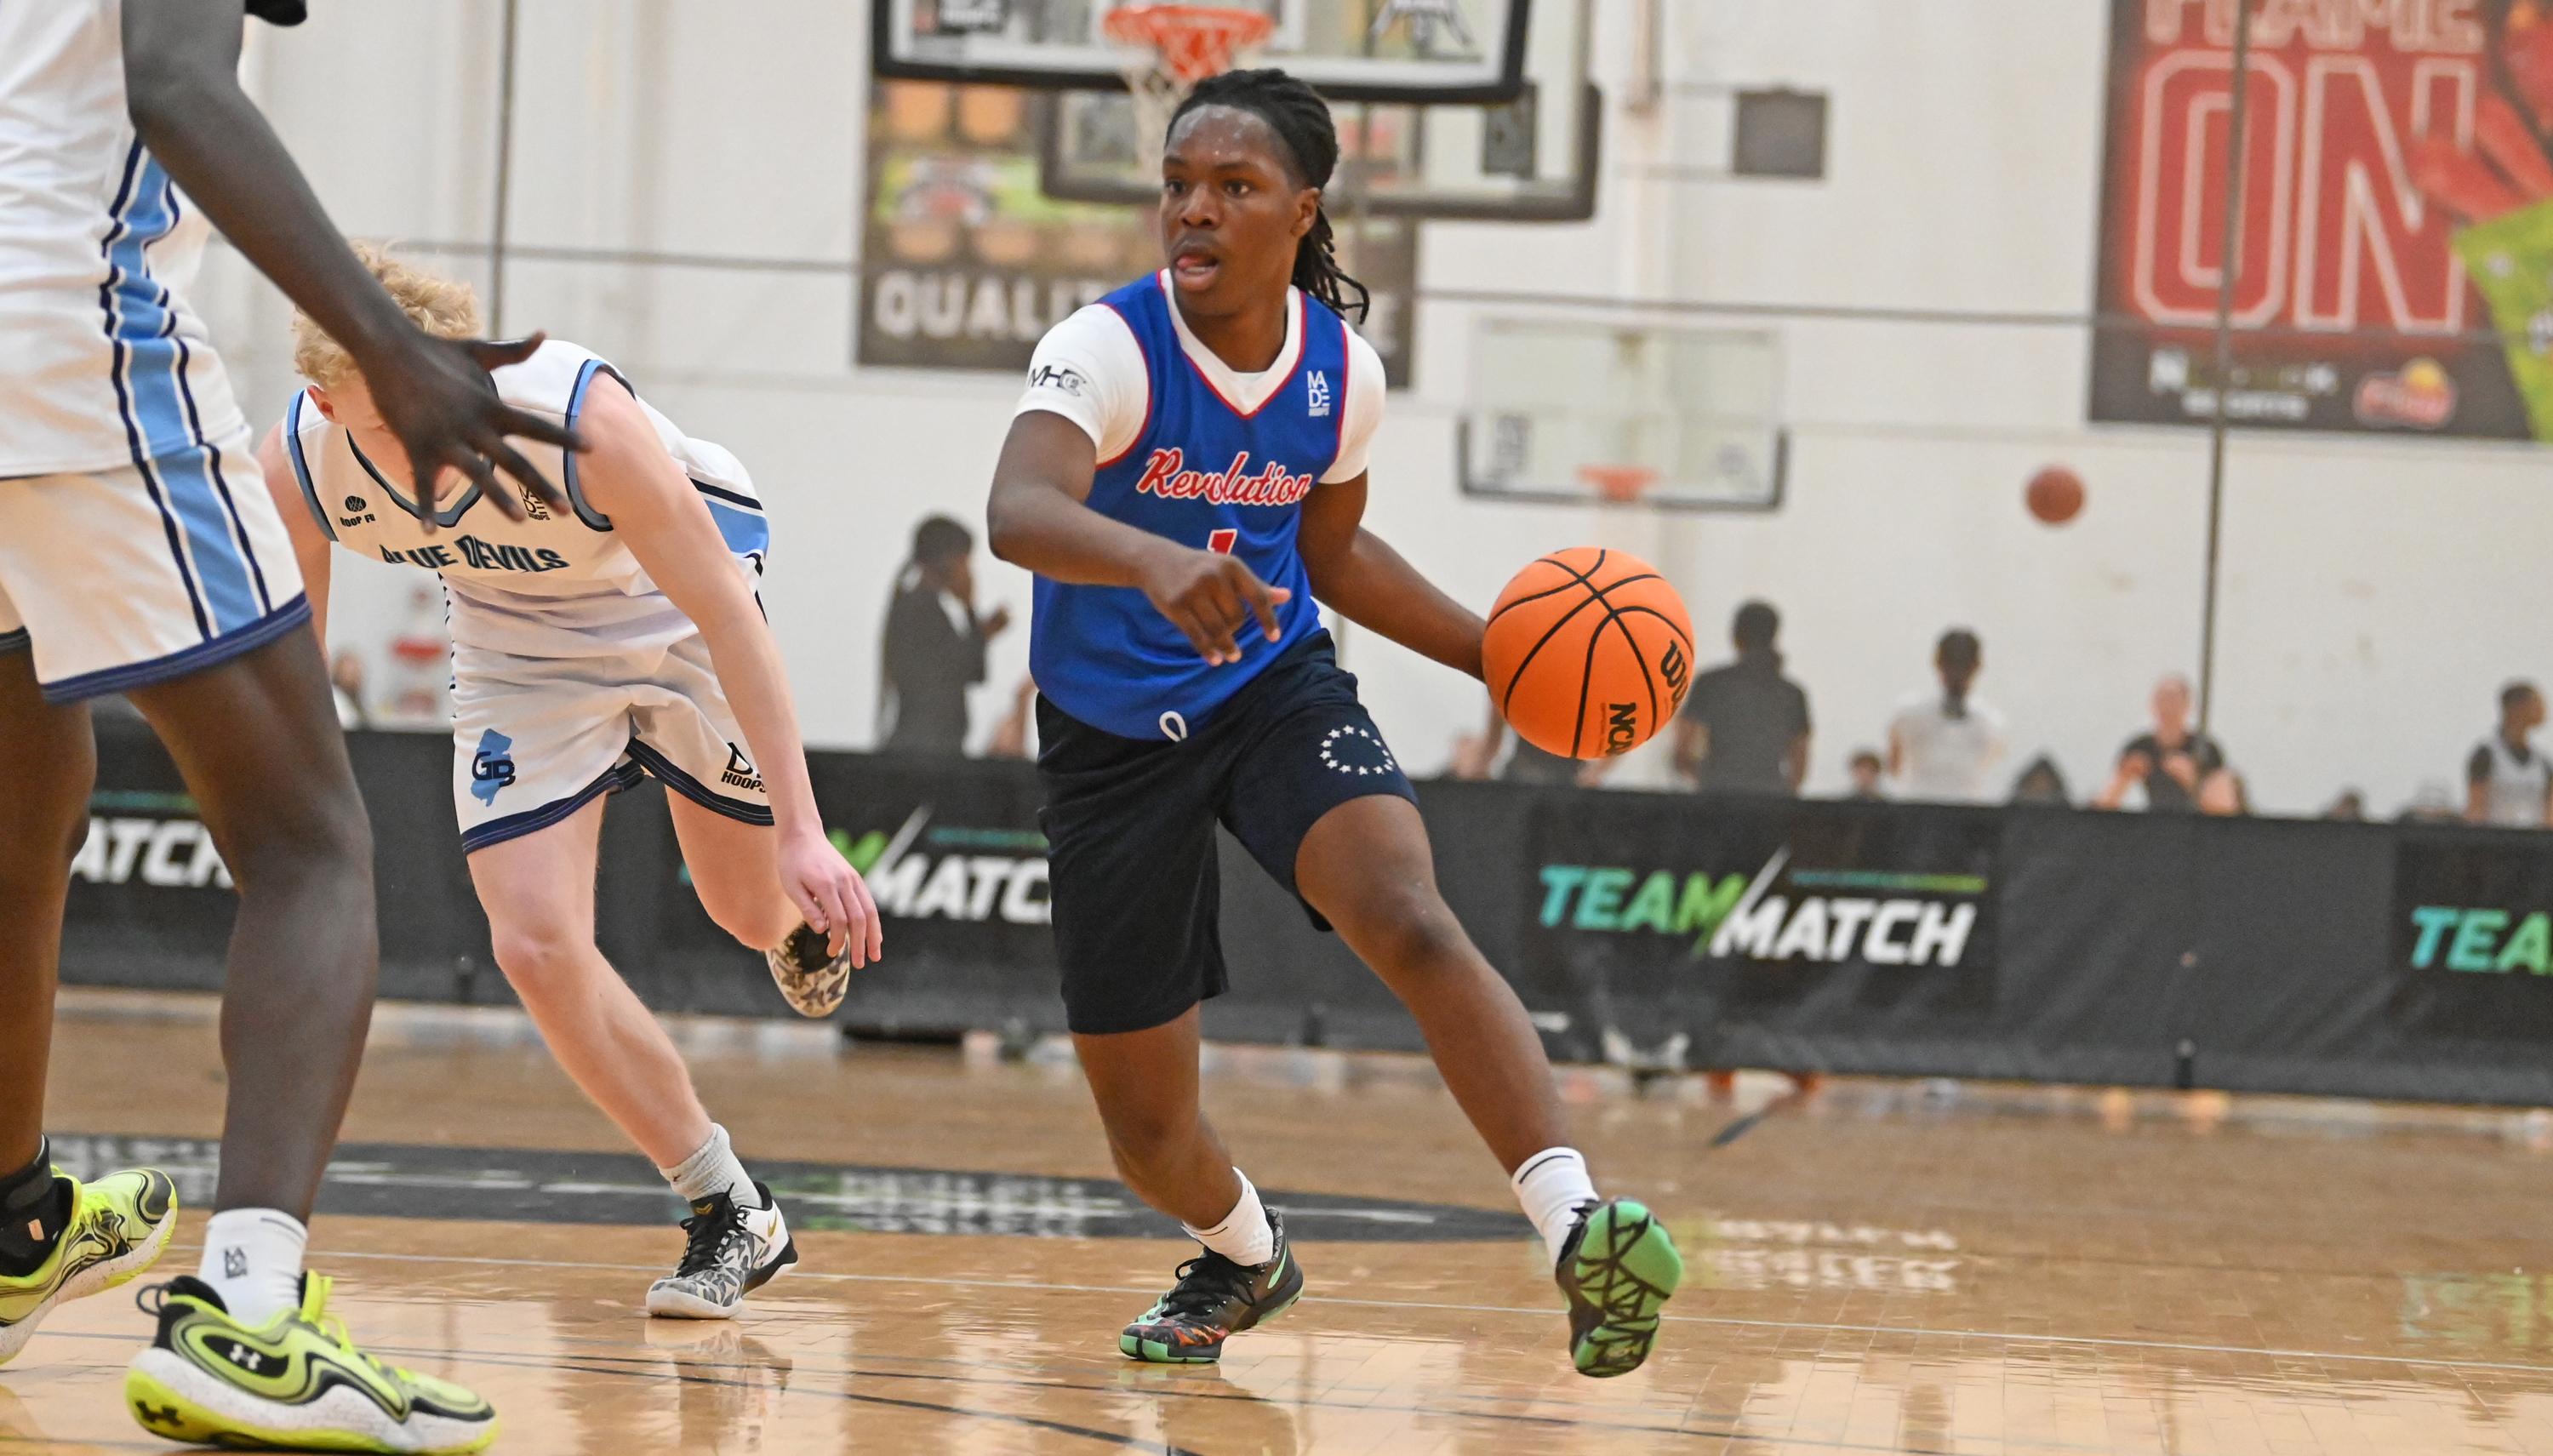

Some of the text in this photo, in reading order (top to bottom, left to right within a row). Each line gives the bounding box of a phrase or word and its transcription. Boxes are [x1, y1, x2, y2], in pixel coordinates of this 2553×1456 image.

[2133, 49, 2476, 334] ON
[1136, 447, 1312, 506] Revolution
[454, 534, 571, 573] DEVILS
[70, 814, 235, 888] ATCH
[863, 851, 1053, 924] MATC
[1539, 863, 1978, 967] TEAM MATCH
[2410, 905, 2553, 977] TEA
